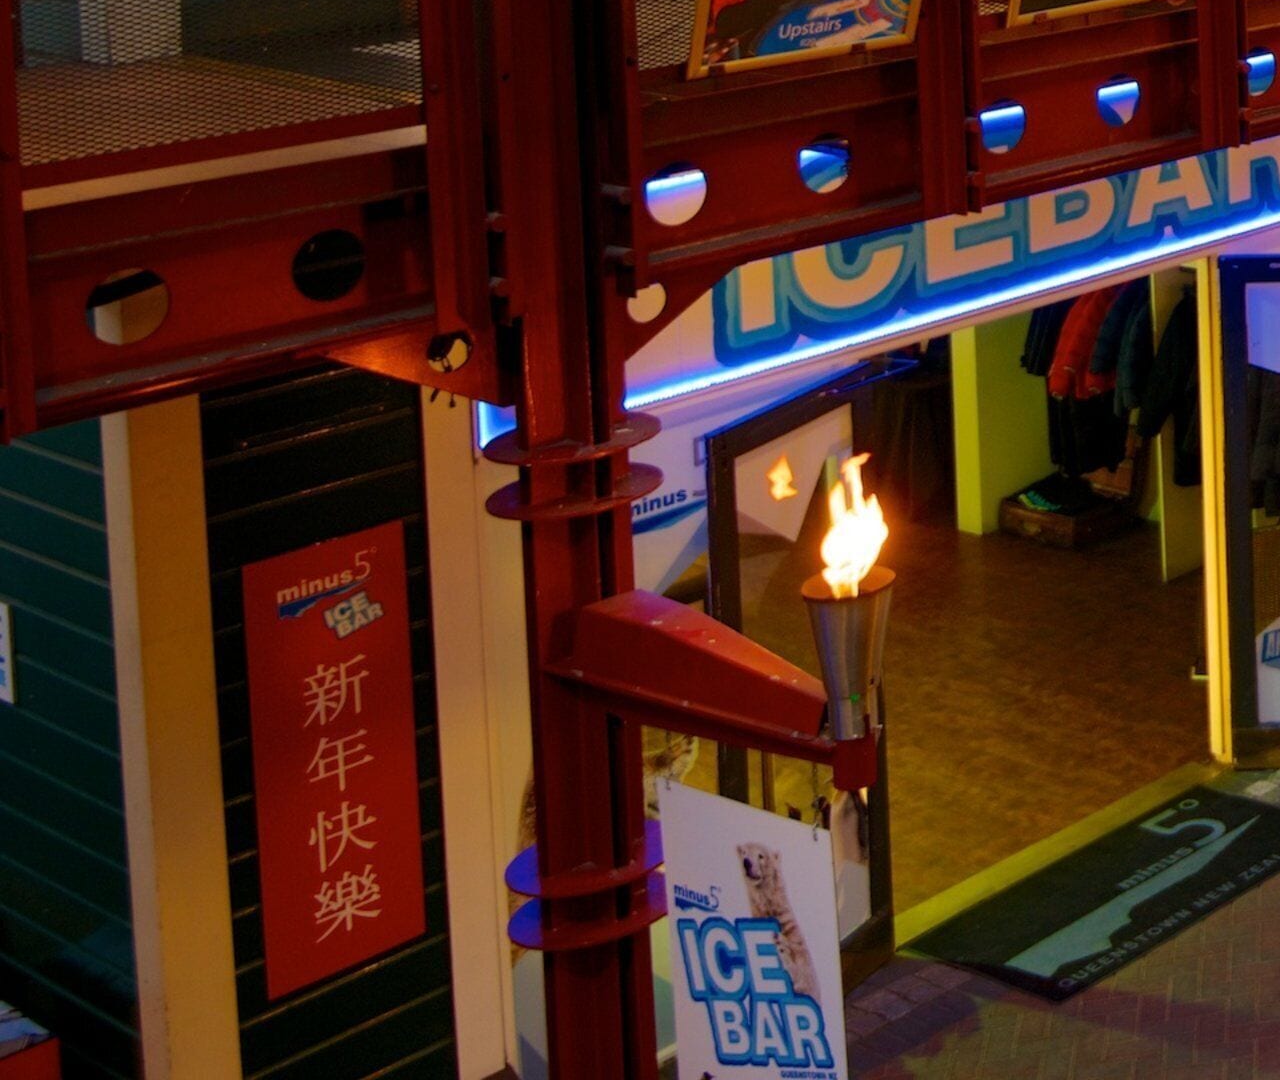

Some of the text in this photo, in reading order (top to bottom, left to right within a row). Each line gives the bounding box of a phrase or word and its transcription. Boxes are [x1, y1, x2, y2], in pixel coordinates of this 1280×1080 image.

[777, 16, 843, 42] Upstairs
[323, 591, 369, 629] ICE
[336, 602, 385, 639] BAR
[302, 653, 382, 944] 新年快樂
[680, 921, 791, 998] ICE
[1058, 907, 1195, 989] QUEENSTOWN
[1194, 880, 1237, 908] NEW
[709, 995, 831, 1065] BAR
